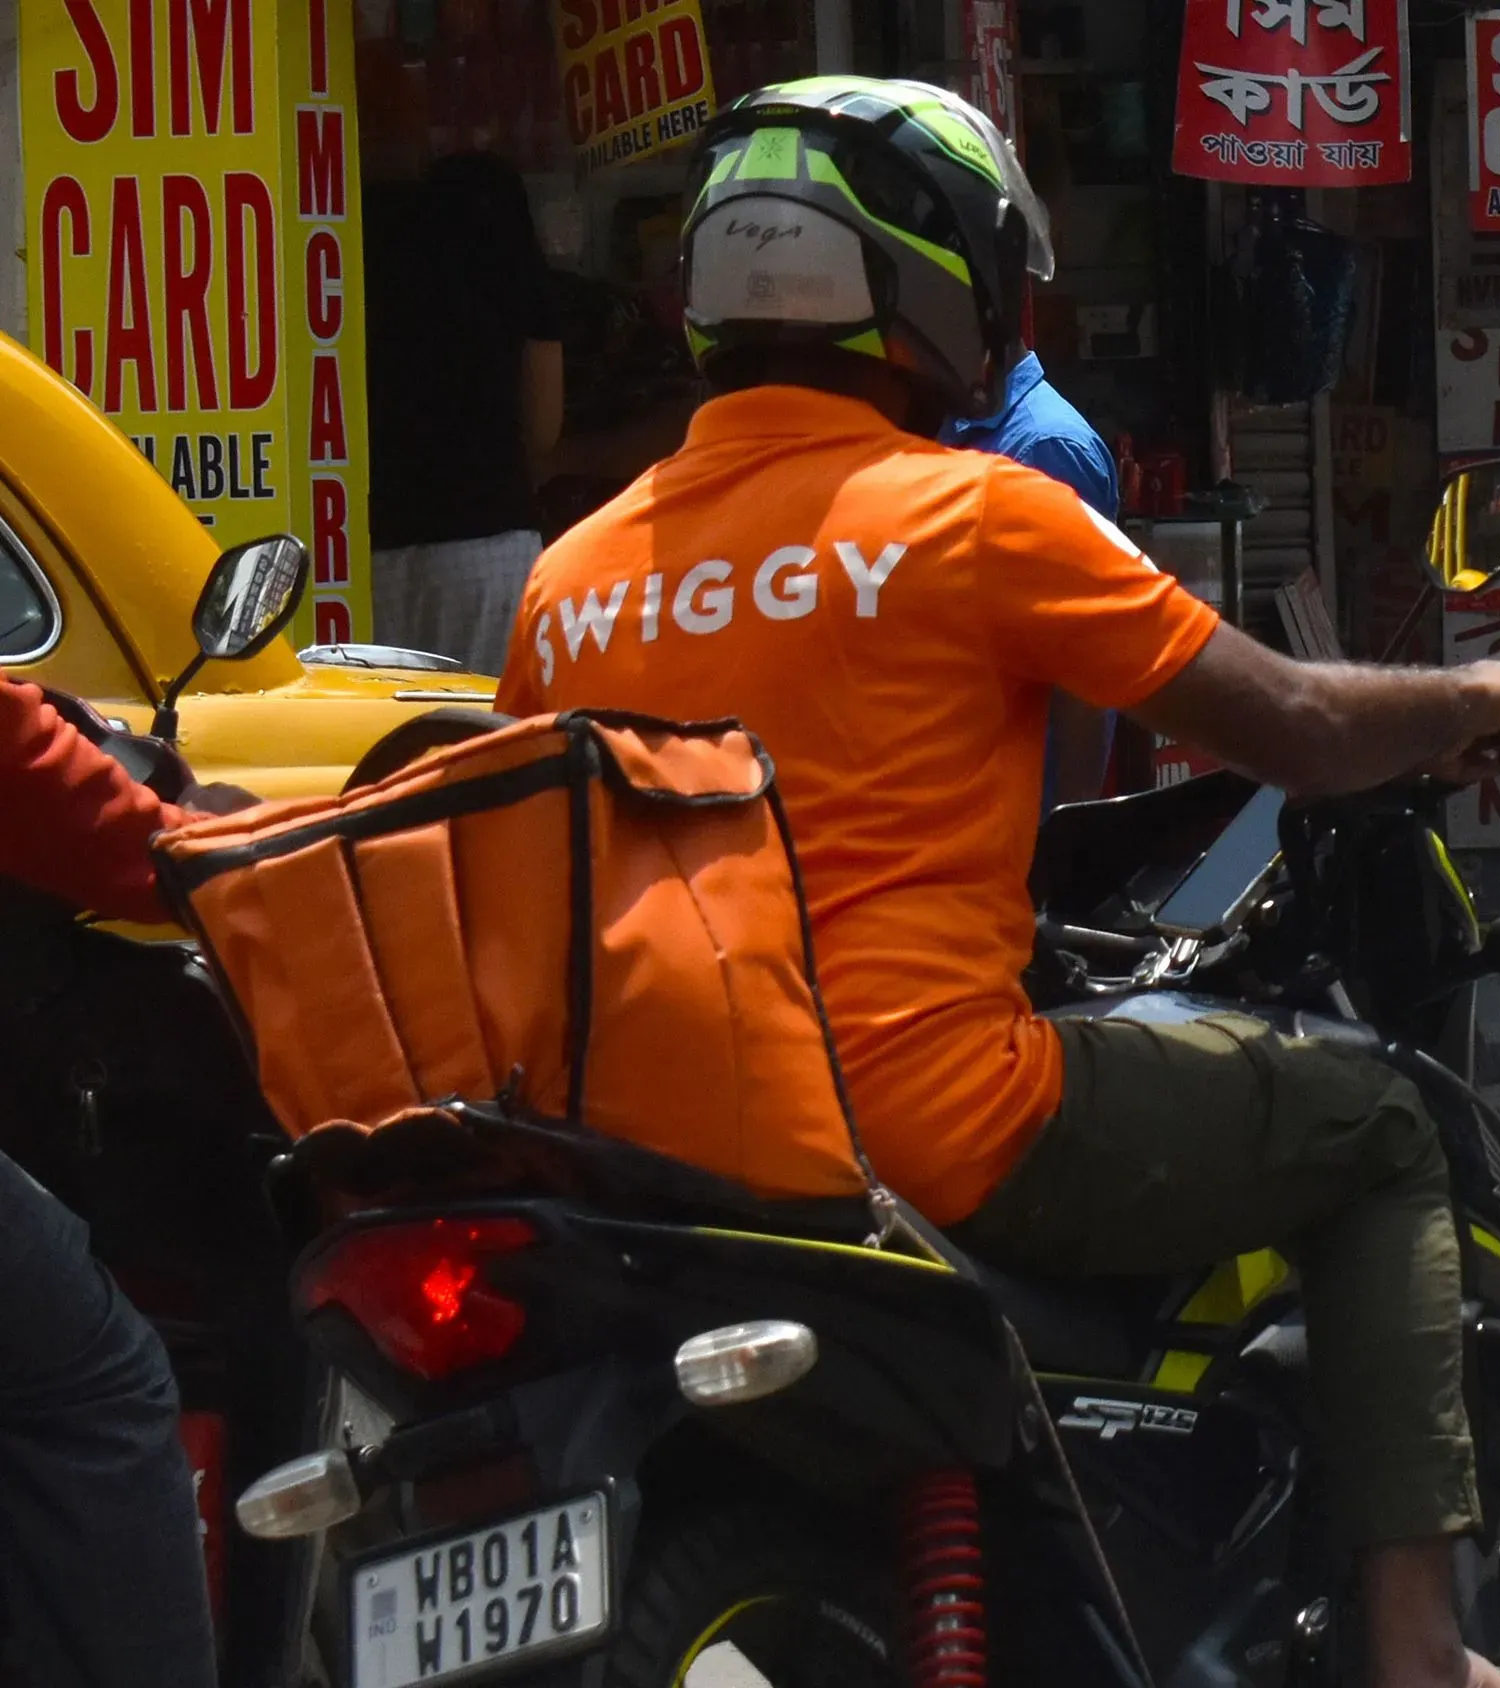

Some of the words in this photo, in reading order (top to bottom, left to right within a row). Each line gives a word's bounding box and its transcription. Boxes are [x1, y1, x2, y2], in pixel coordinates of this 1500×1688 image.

[54, 0, 255, 143] SIM
[566, 15, 705, 145] CARD
[1193, 46, 1391, 130] কার্ড
[577, 124, 653, 175] AVAILABLE
[659, 100, 709, 142] HERE
[41, 173, 278, 414] CARD
[534, 541, 907, 687] SWIGGY
[415, 1511, 579, 1613] WB01A
[415, 1572, 580, 1677] W1970
